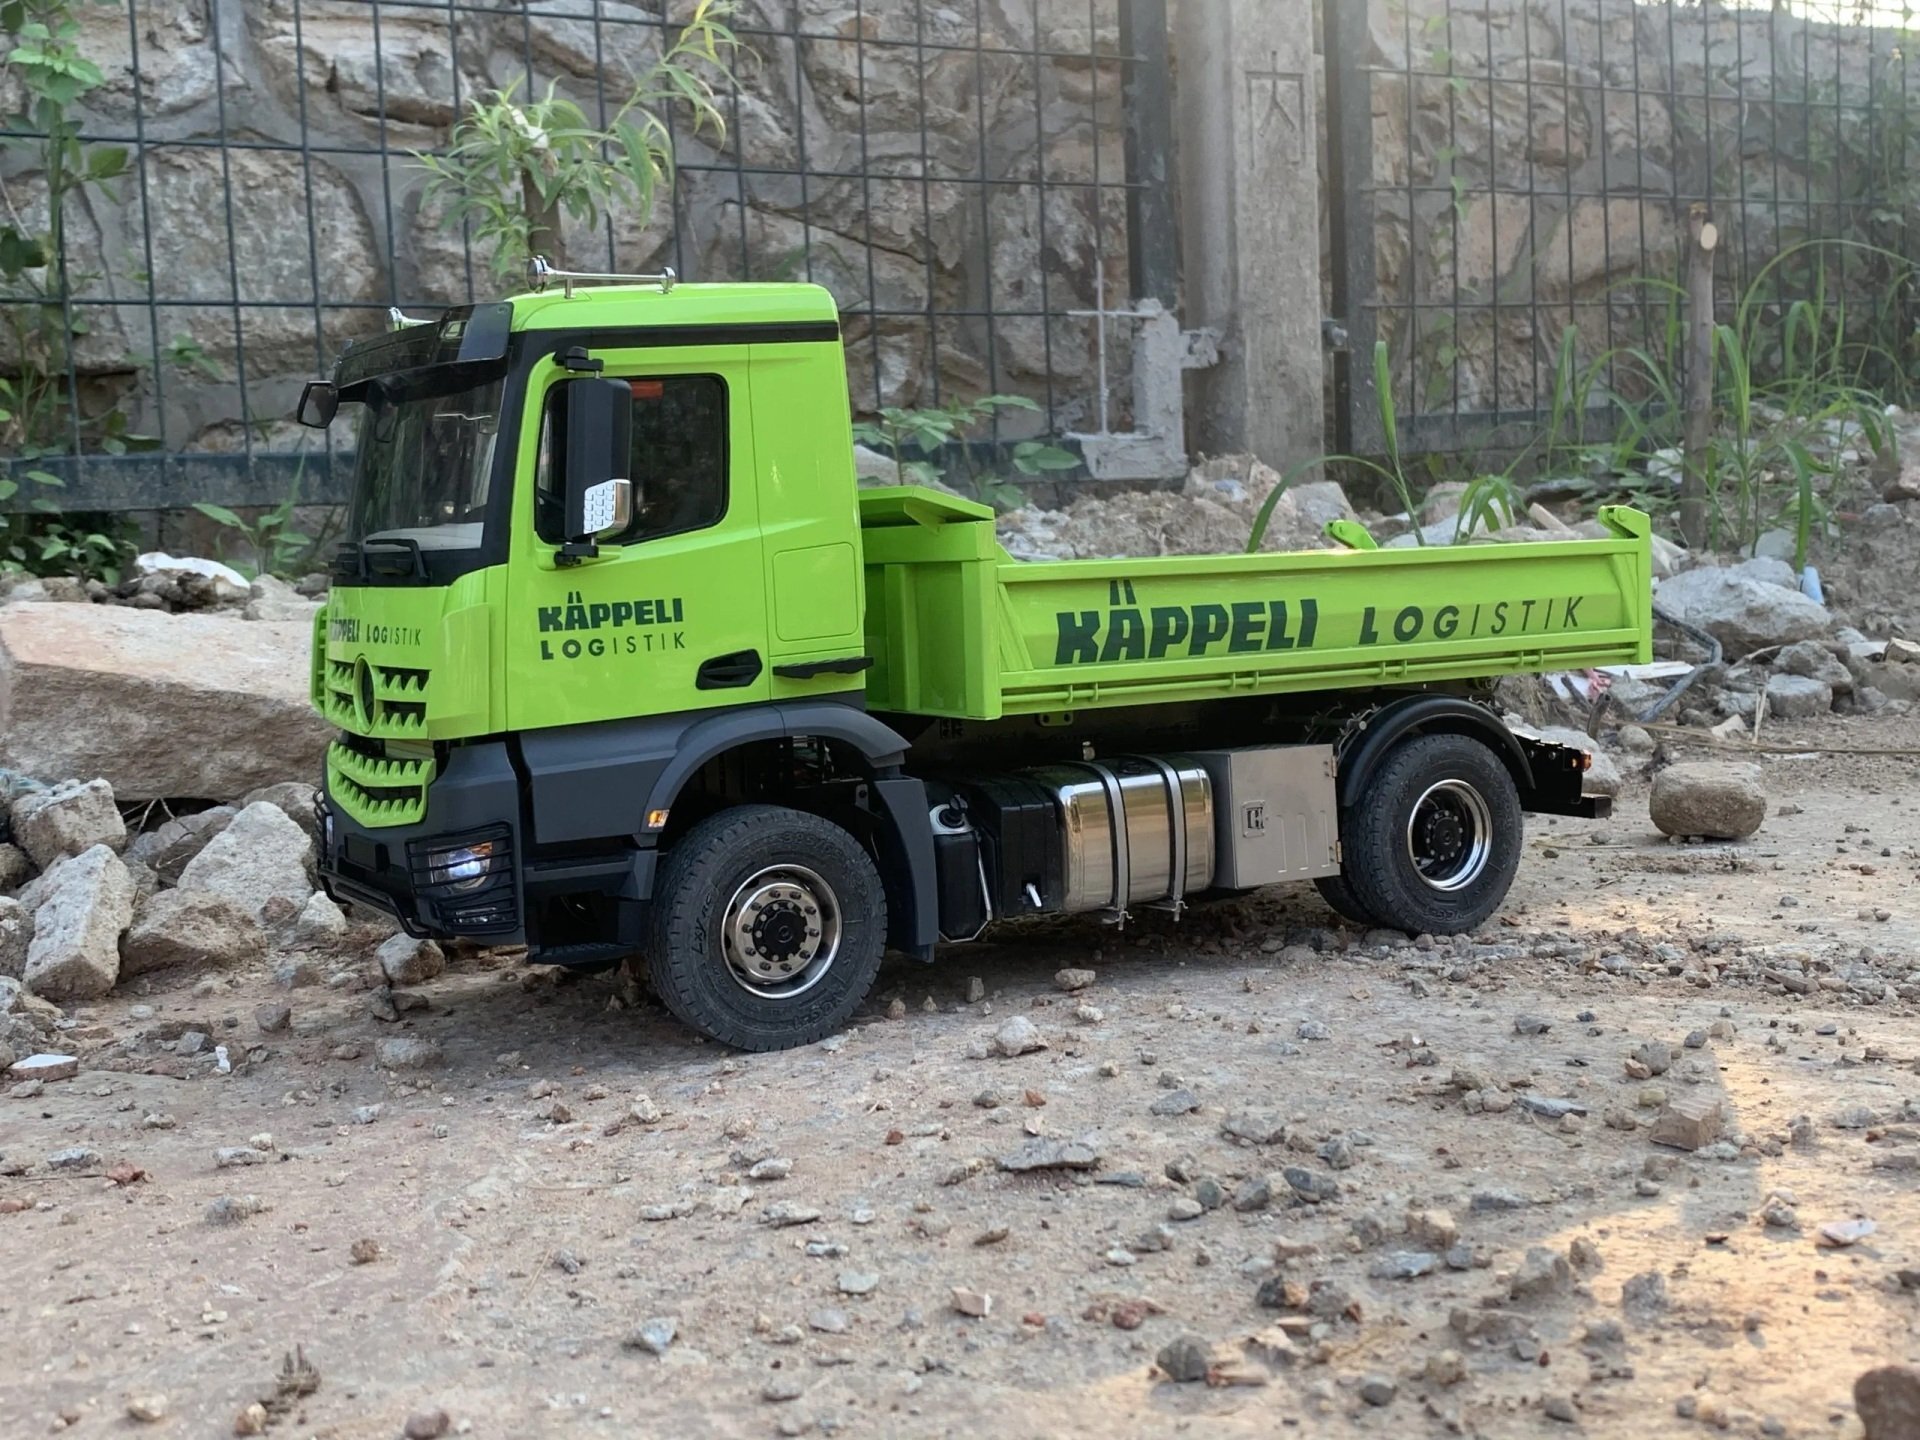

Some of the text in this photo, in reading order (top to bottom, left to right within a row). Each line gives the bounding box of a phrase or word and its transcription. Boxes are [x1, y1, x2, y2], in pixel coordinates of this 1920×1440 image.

[538, 591, 684, 632] KÄPPELI
[1054, 579, 1584, 665] KÄPPELI LOGISTIK
[366, 623, 421, 646] LOGISTIK
[540, 631, 685, 660] LOGISTIK
